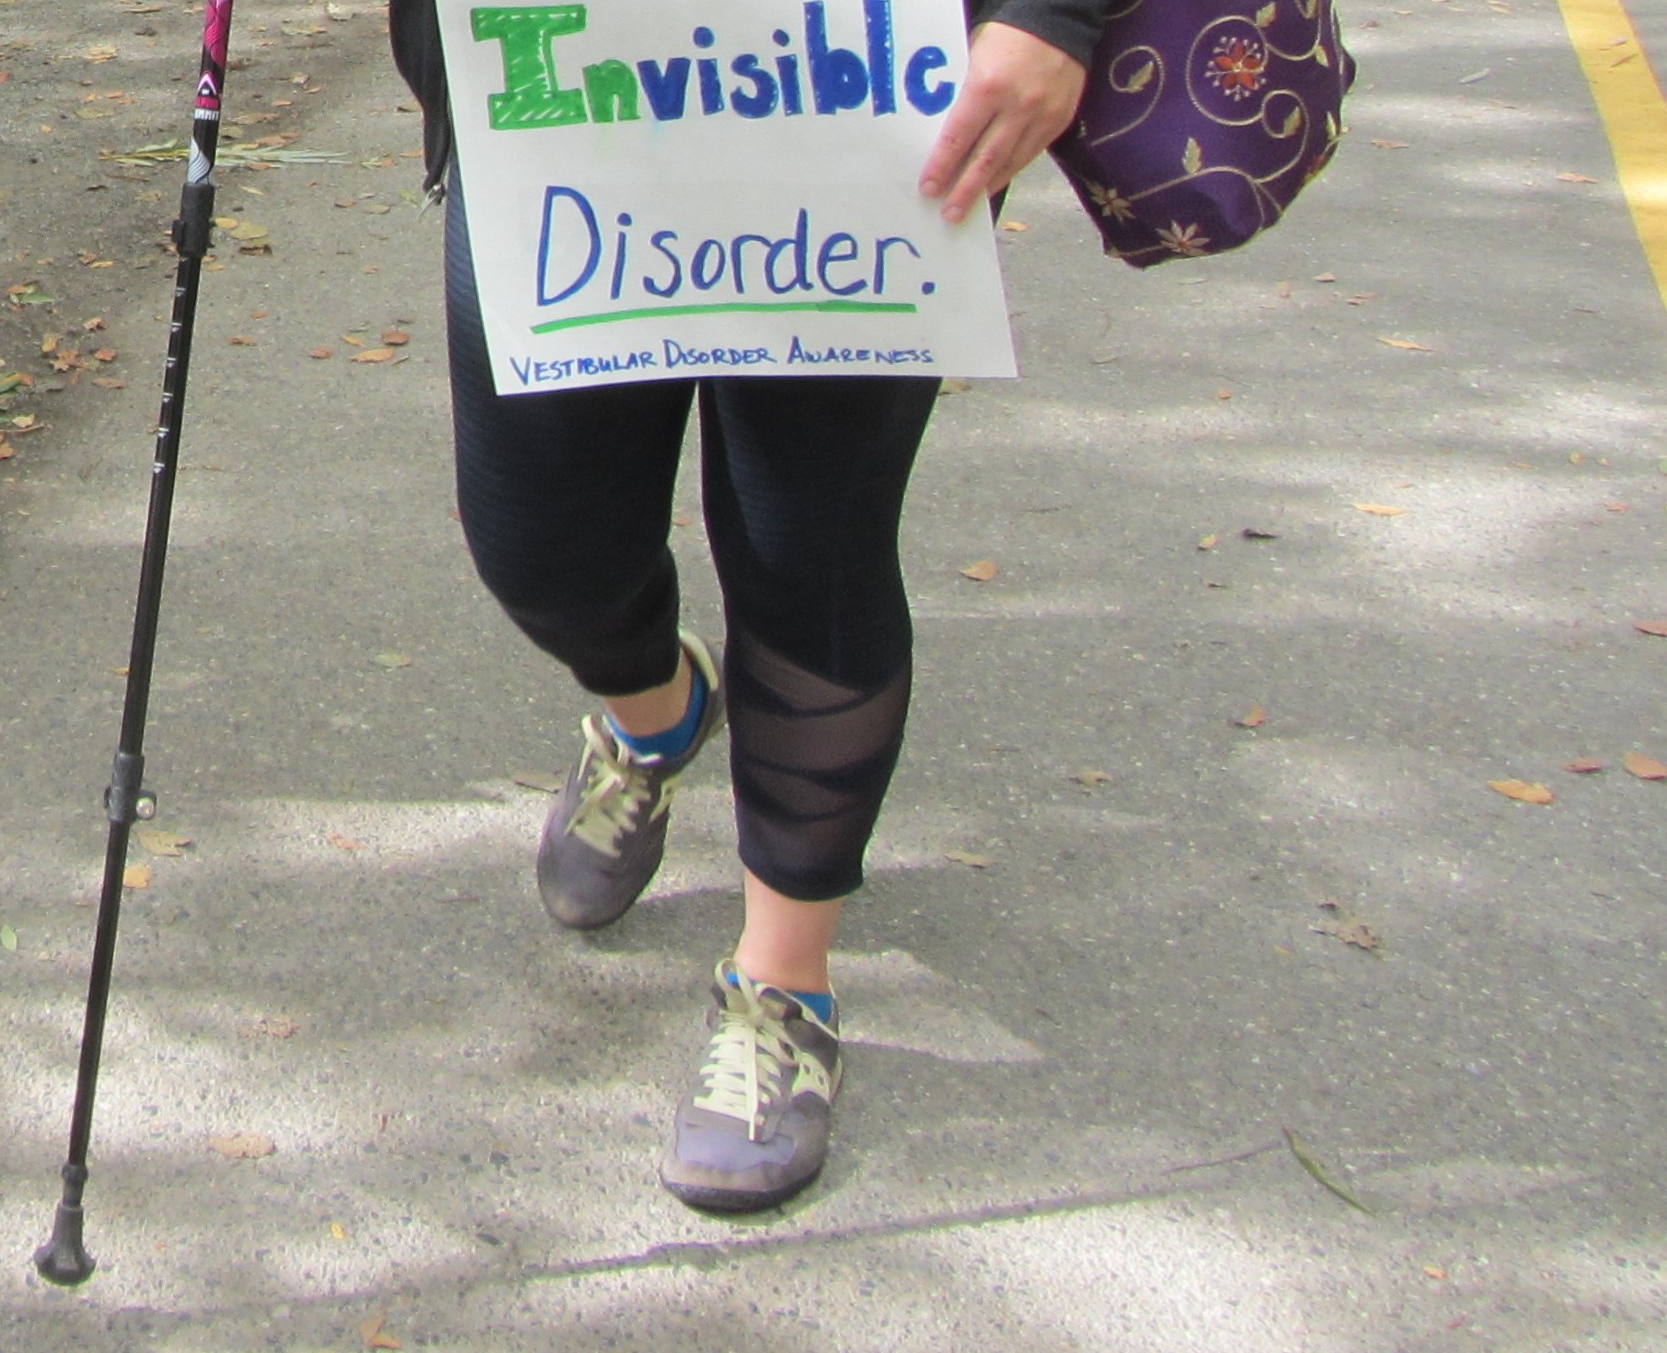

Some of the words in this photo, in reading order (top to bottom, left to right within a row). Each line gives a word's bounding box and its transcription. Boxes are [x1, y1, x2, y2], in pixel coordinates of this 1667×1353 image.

[536, 185, 937, 307] Disorder.
[509, 351, 657, 387] VESTIBULAR
[787, 336, 936, 365] AWARENESS
